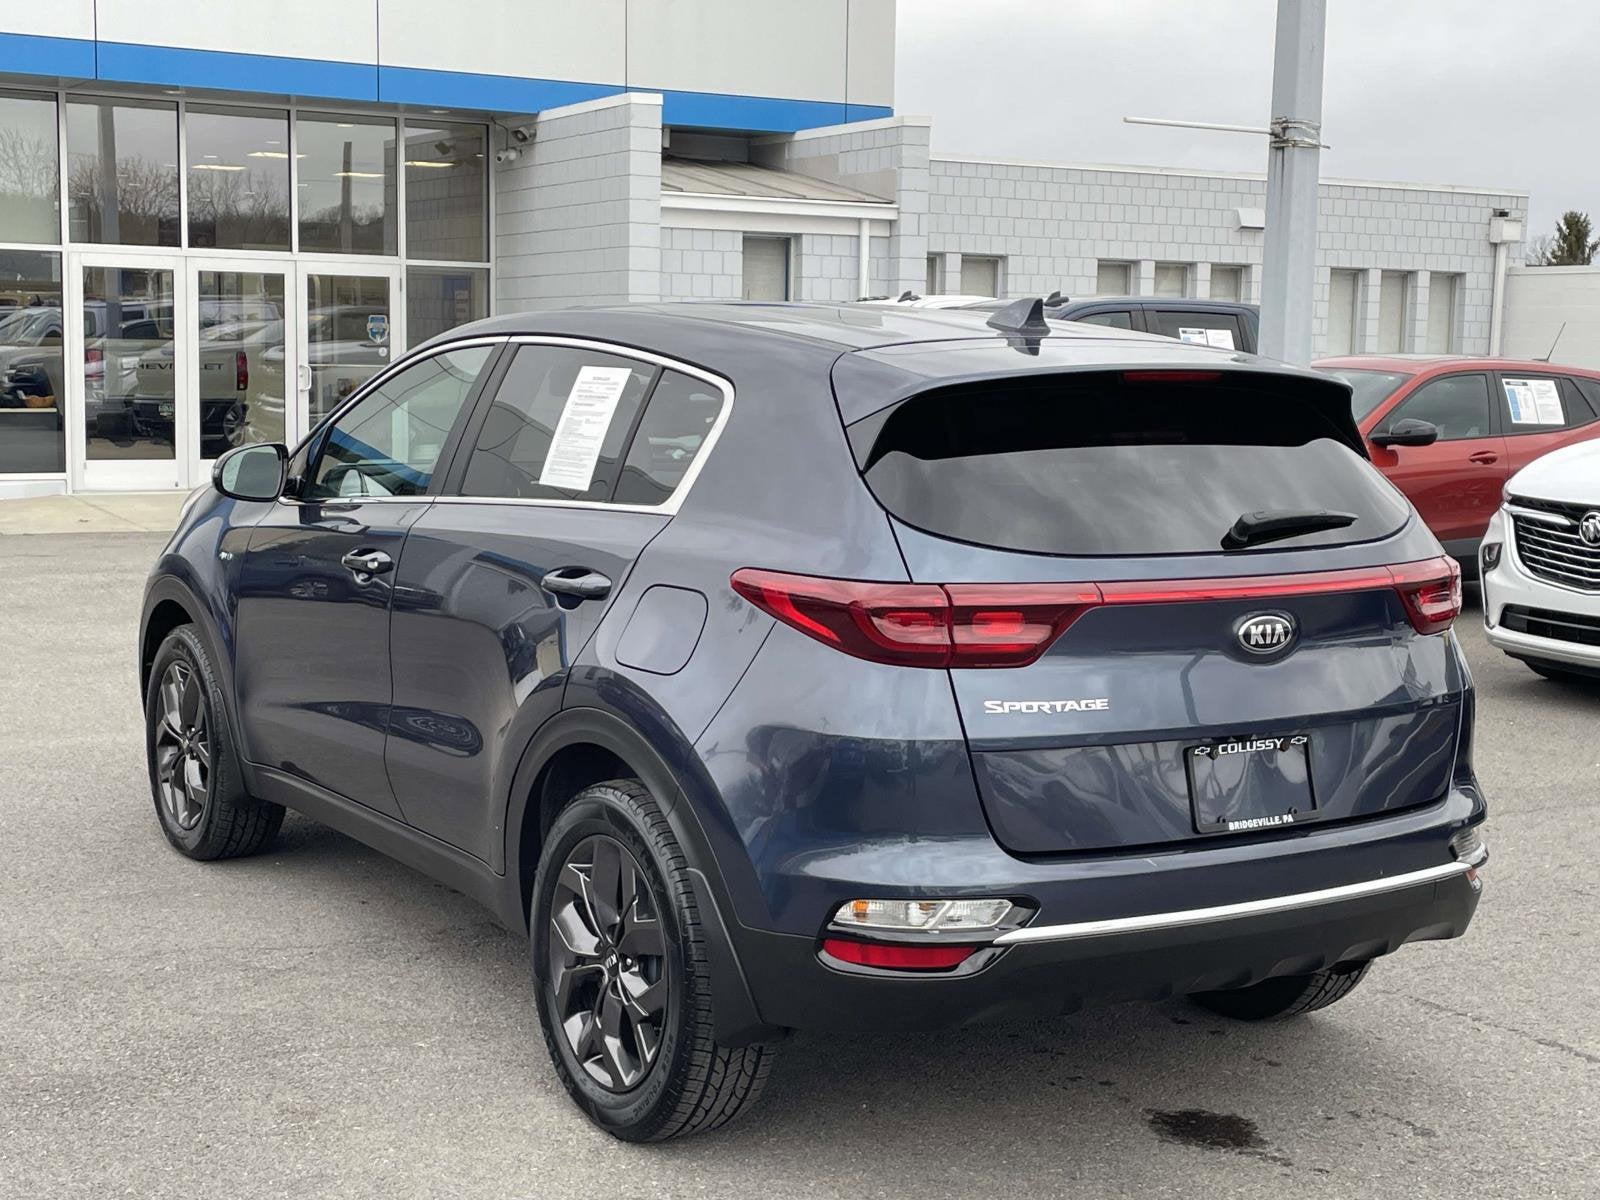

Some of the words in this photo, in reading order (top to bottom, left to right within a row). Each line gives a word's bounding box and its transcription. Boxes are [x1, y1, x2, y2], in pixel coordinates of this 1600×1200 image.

[1249, 624, 1285, 645] KIA
[984, 698, 1110, 714] SPORTAGE
[1218, 738, 1284, 755] COLUSSY
[1283, 814, 1294, 823] PA
